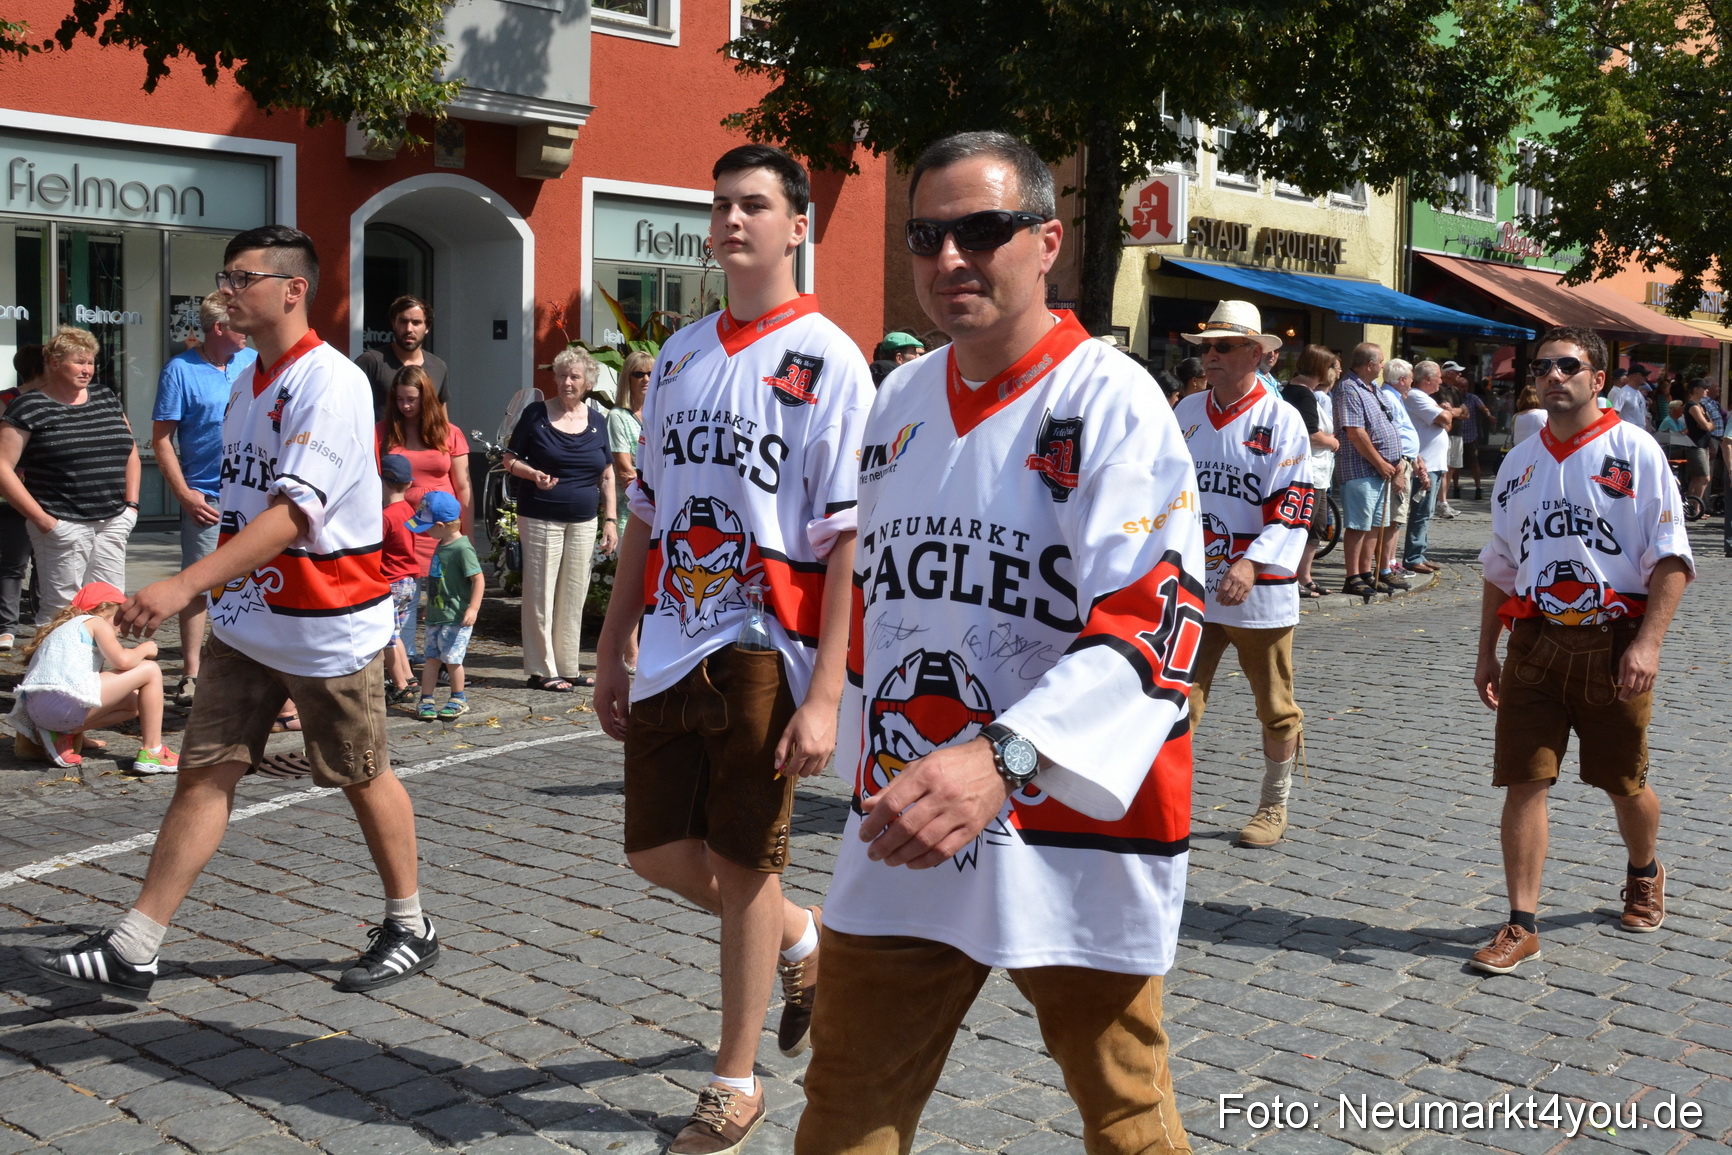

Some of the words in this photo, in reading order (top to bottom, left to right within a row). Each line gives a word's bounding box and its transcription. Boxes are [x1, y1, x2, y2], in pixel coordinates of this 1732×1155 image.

[9, 157, 204, 217] fielmann
[1195, 216, 1252, 252] STADT
[1263, 227, 1348, 265] APOTHEKE
[75, 304, 142, 325] fielmann
[781, 364, 812, 391] 38
[666, 409, 757, 435] NEUMARKT
[663, 426, 789, 494] AGLES
[1045, 439, 1073, 474] 38
[1197, 470, 1263, 506] GLES
[1605, 466, 1632, 488] 38
[880, 516, 1030, 552] NEUMARKT
[1135, 574, 1203, 687] 10
